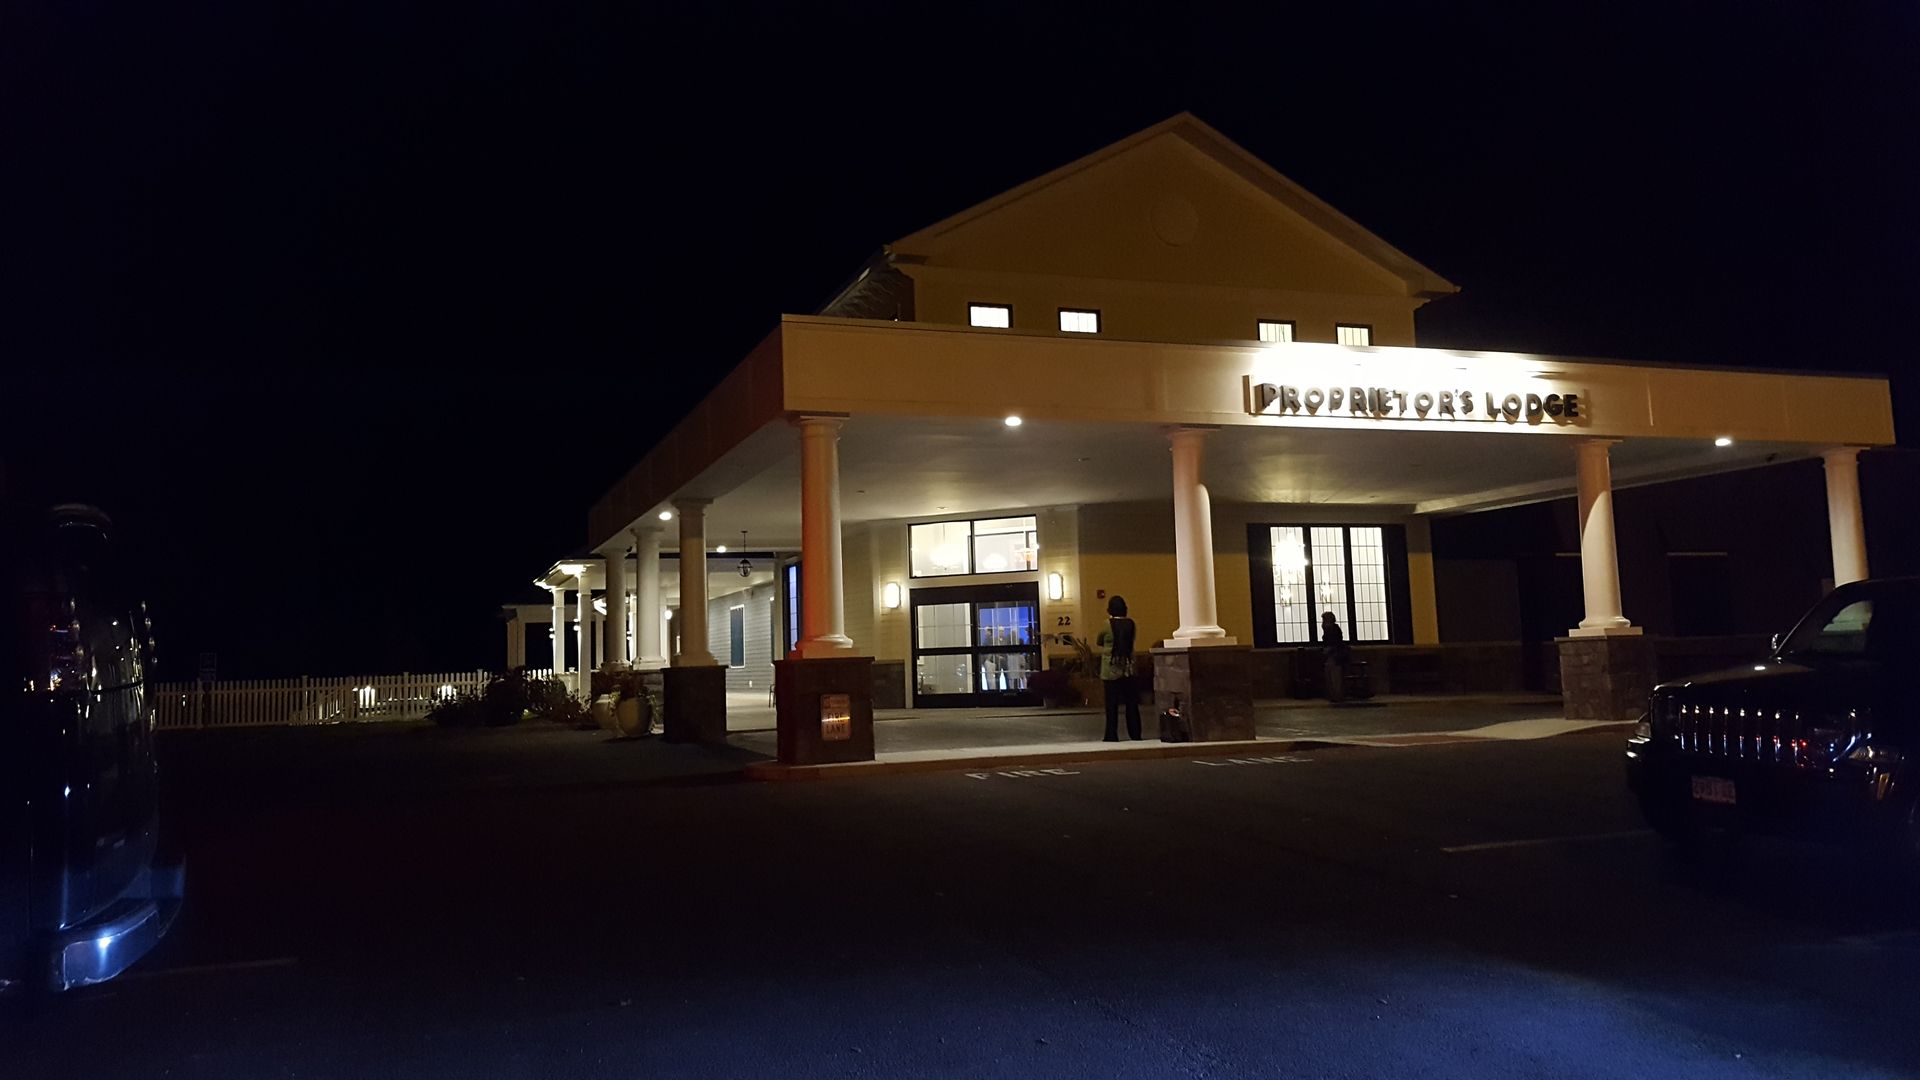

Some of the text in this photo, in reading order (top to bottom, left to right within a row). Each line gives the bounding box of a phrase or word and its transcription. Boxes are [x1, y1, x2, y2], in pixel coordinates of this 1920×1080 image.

[1258, 383, 1579, 420] PROPRIETOR'S LODGE
[1058, 616, 1071, 626] 22
[964, 756, 1314, 780] FIRE LANE
